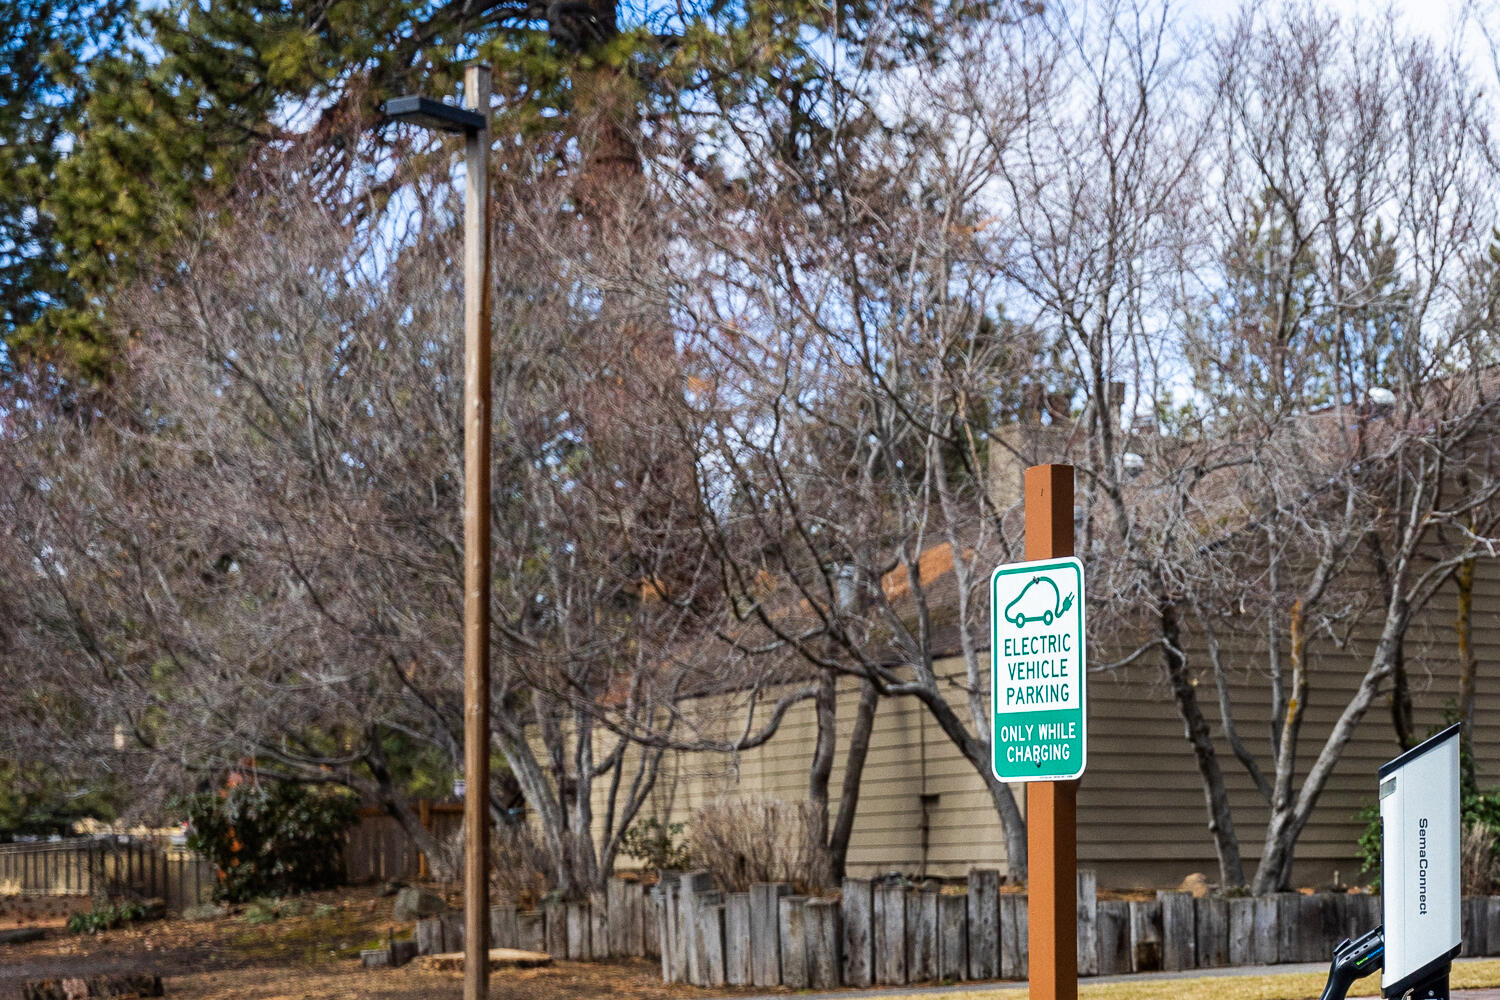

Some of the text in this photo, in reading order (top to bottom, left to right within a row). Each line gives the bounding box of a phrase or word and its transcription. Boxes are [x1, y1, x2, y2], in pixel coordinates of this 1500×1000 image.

[1004, 633, 1071, 657] ELECTRIC
[1008, 658, 1068, 681] VEHICLE
[1006, 683, 1070, 706] PARKING
[1000, 722, 1076, 743] ONLY WHILE
[1006, 743, 1070, 763] CHARGING
[1418, 818, 1429, 915] SemaConnect
